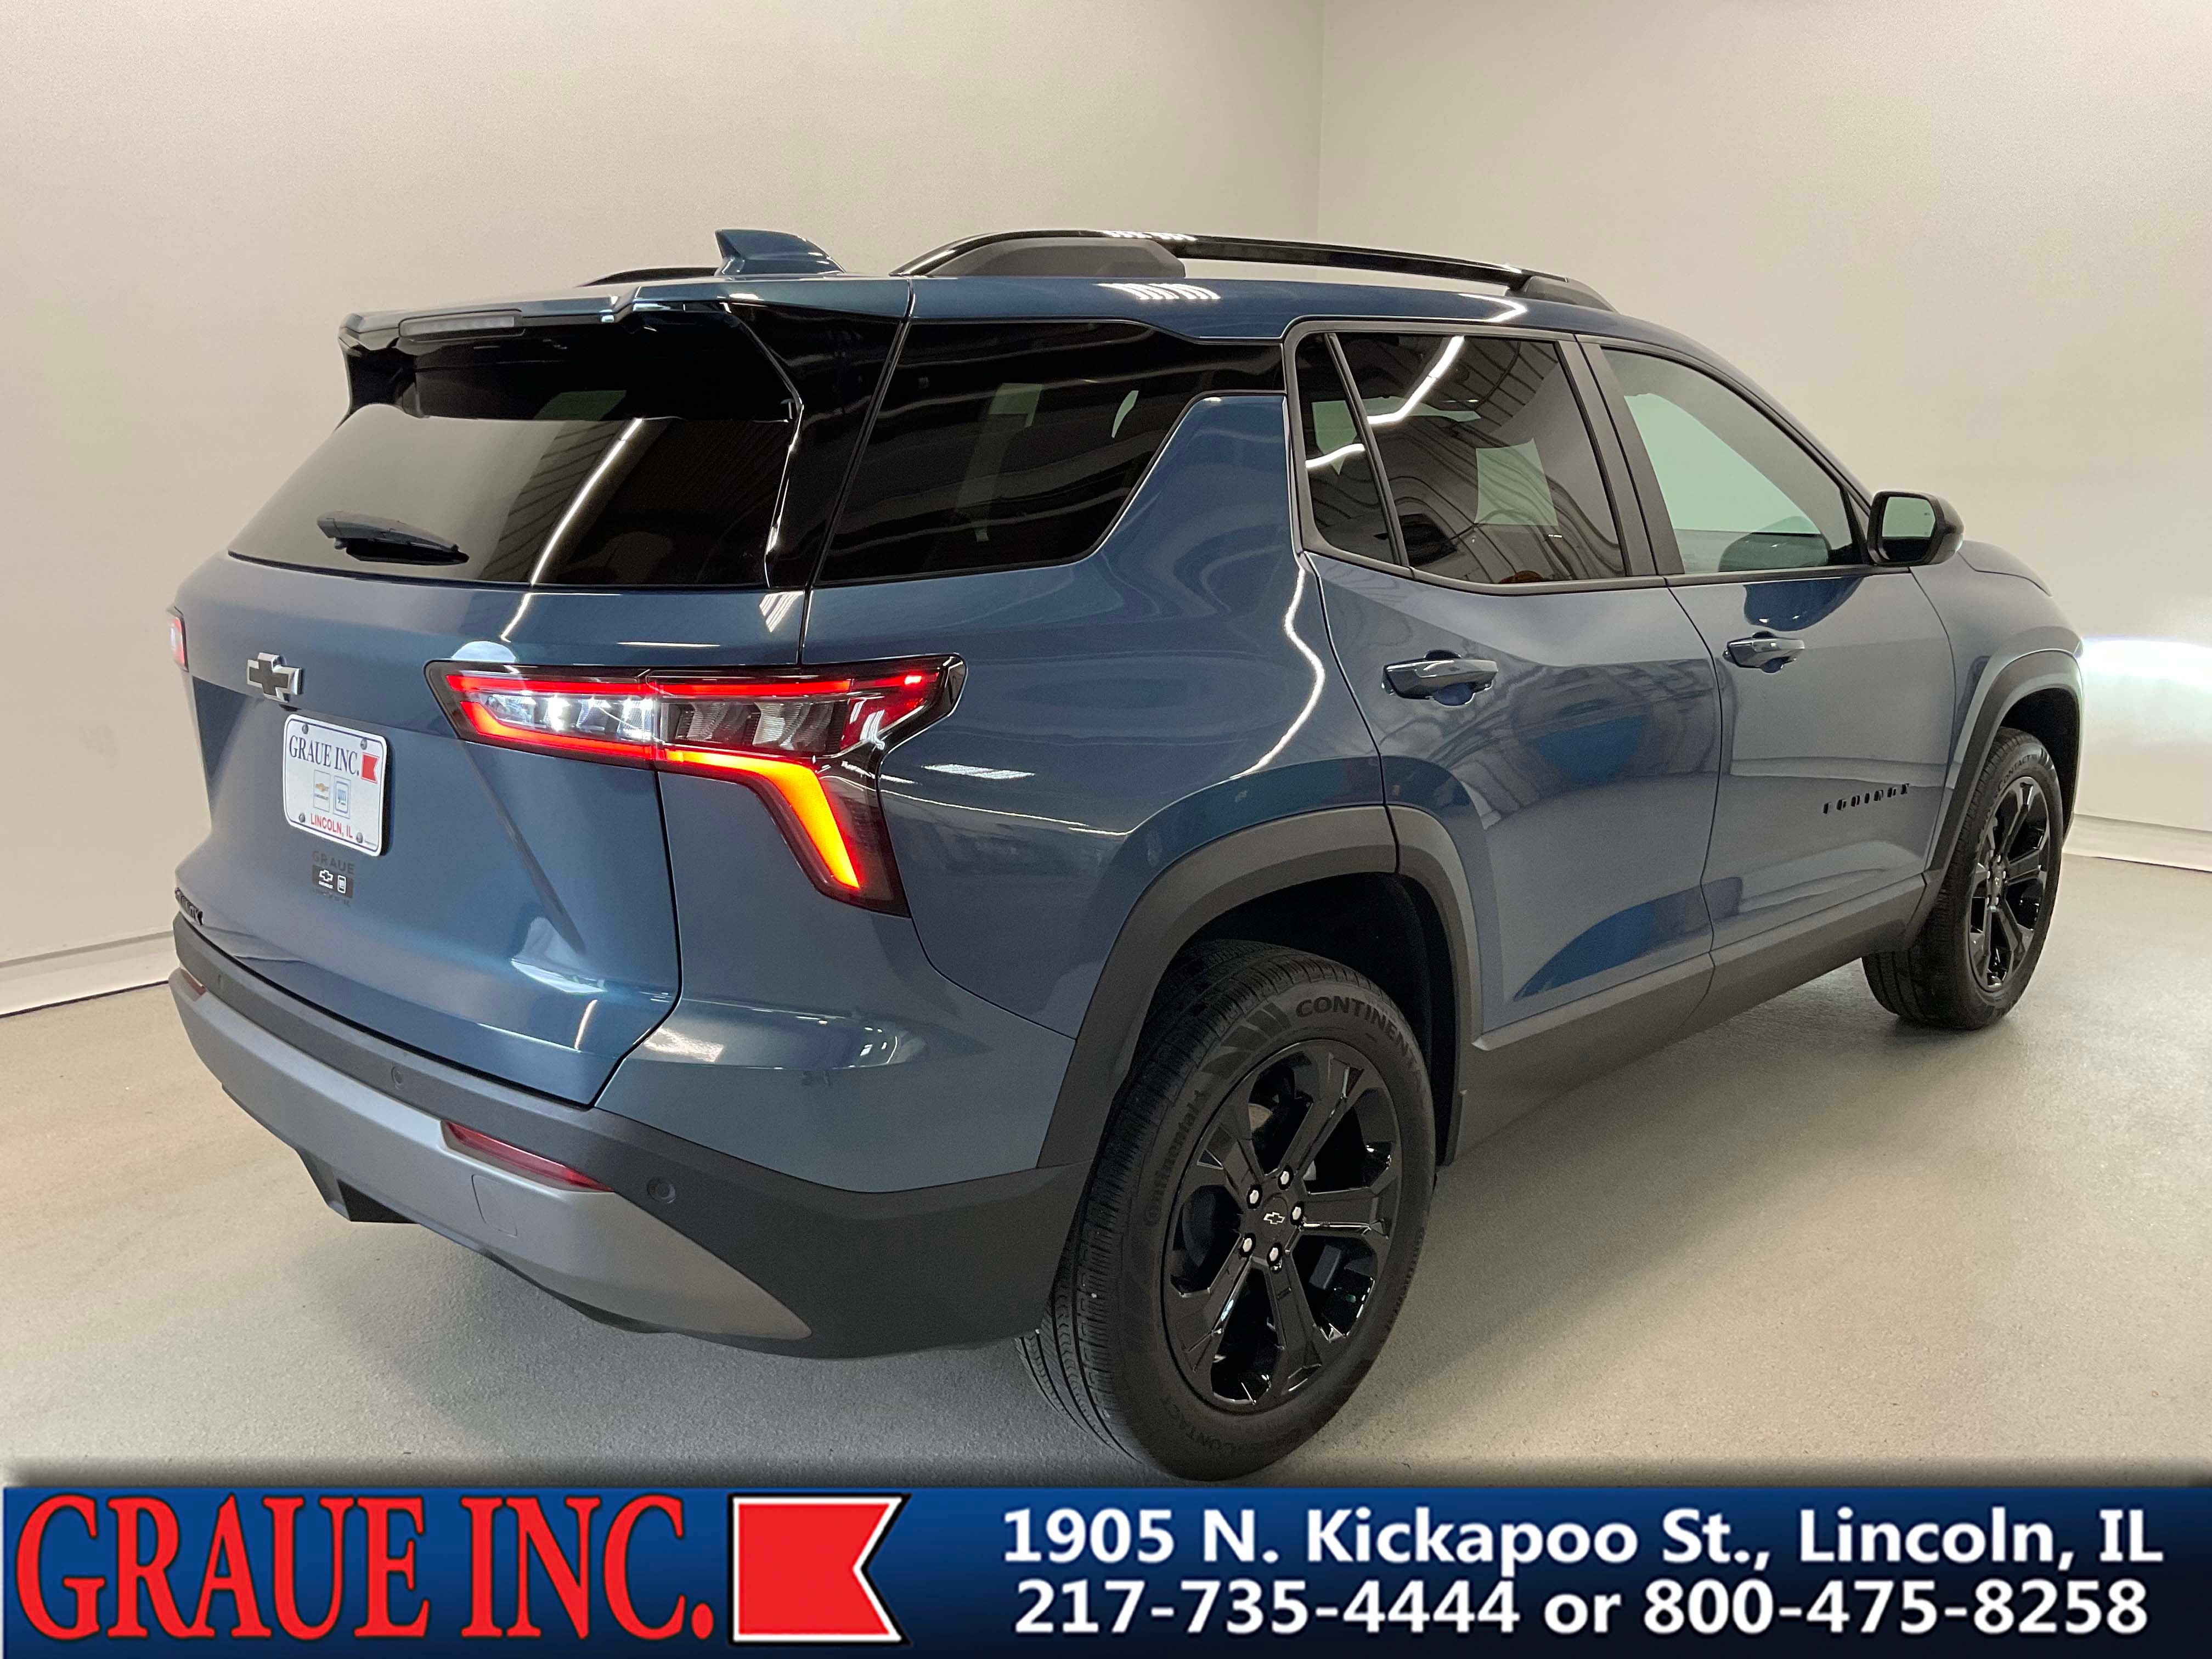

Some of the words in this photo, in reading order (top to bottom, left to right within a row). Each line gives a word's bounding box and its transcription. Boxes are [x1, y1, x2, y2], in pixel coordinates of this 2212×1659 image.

[289, 735, 332, 768] GRAUE
[334, 747, 359, 776] INC.
[311, 813, 344, 837] LINCOLN,
[346, 825, 353, 839] IL
[312, 850, 356, 874] GRAUE
